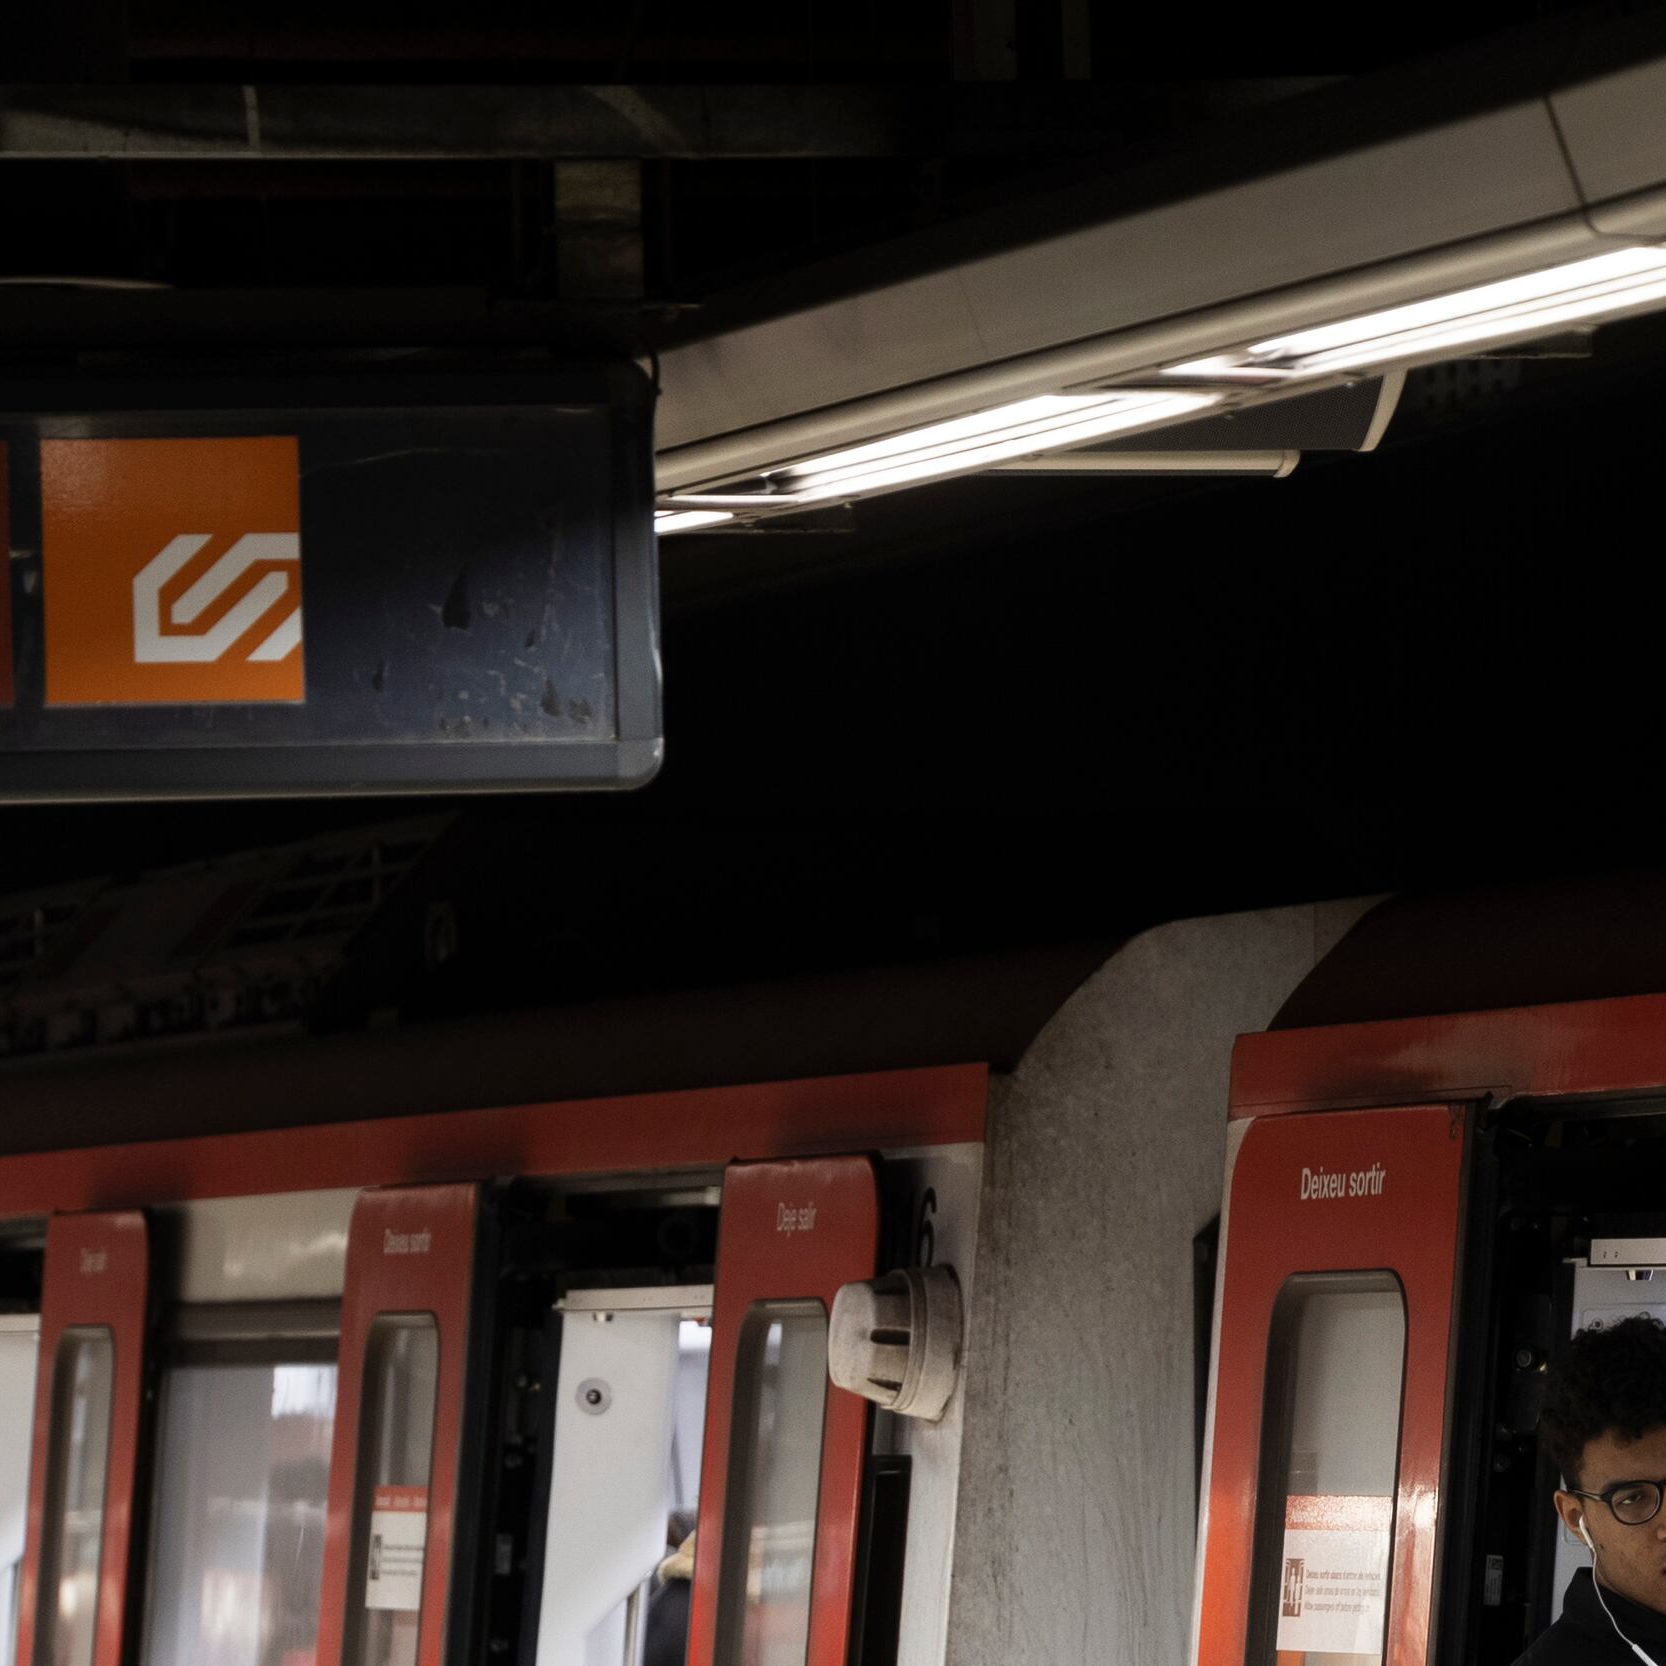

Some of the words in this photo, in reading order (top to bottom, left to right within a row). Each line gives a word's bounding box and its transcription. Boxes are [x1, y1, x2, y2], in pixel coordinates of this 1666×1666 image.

[1300, 1166, 1346, 1200] Deixeu
[1348, 1161, 1387, 1197] sortir
[776, 1201, 797, 1238] Deje
[797, 1201, 818, 1231] salir
